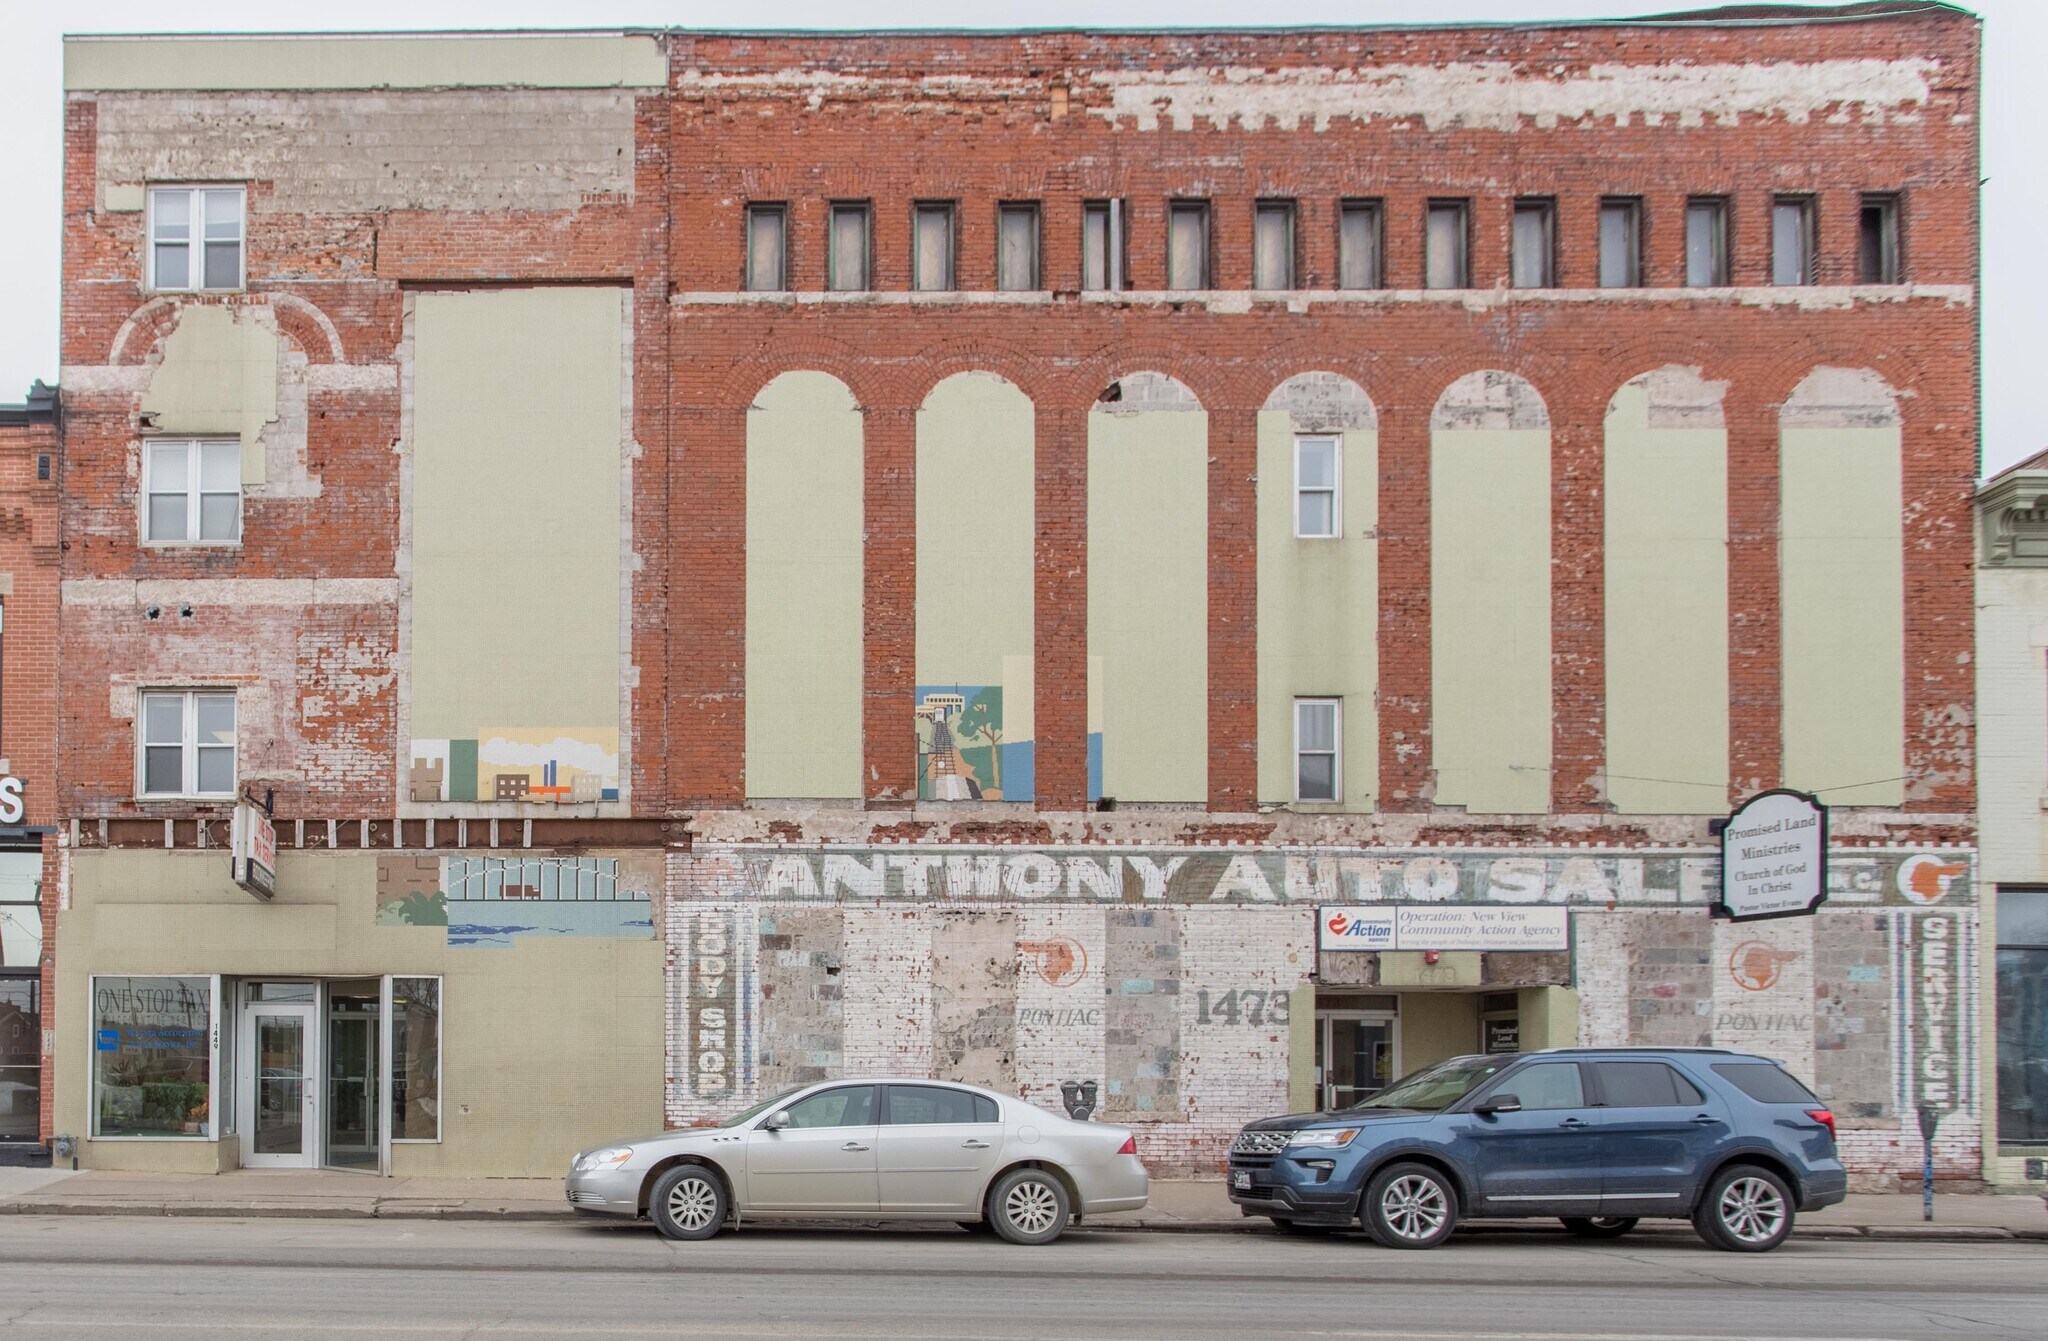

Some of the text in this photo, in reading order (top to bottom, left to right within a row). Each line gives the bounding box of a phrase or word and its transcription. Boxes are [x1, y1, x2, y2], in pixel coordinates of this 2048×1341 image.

[1727, 814, 1816, 841] Promised Land
[1741, 842, 1801, 860] Ministries
[758, 853, 1191, 900] ANTHONY
[1209, 854, 1459, 901] AUTO
[1488, 855, 1724, 903] SALE
[1734, 862, 1806, 882] Church of God
[1748, 882, 1792, 896] In Christ
[1400, 911, 1529, 926] Operation: New View
[1344, 920, 1391, 937] Action
[1400, 925, 1562, 937] Community Action Agency
[97, 988, 209, 1013] ONE STOP TAX
[1195, 988, 1290, 1026] 1473
[1018, 1008, 1100, 1027] PONTIAC
[1715, 1013, 1811, 1031] PONTIAC
[1922, 917, 1950, 1108] SERVICE
[698, 1008, 727, 1095] SHOP
